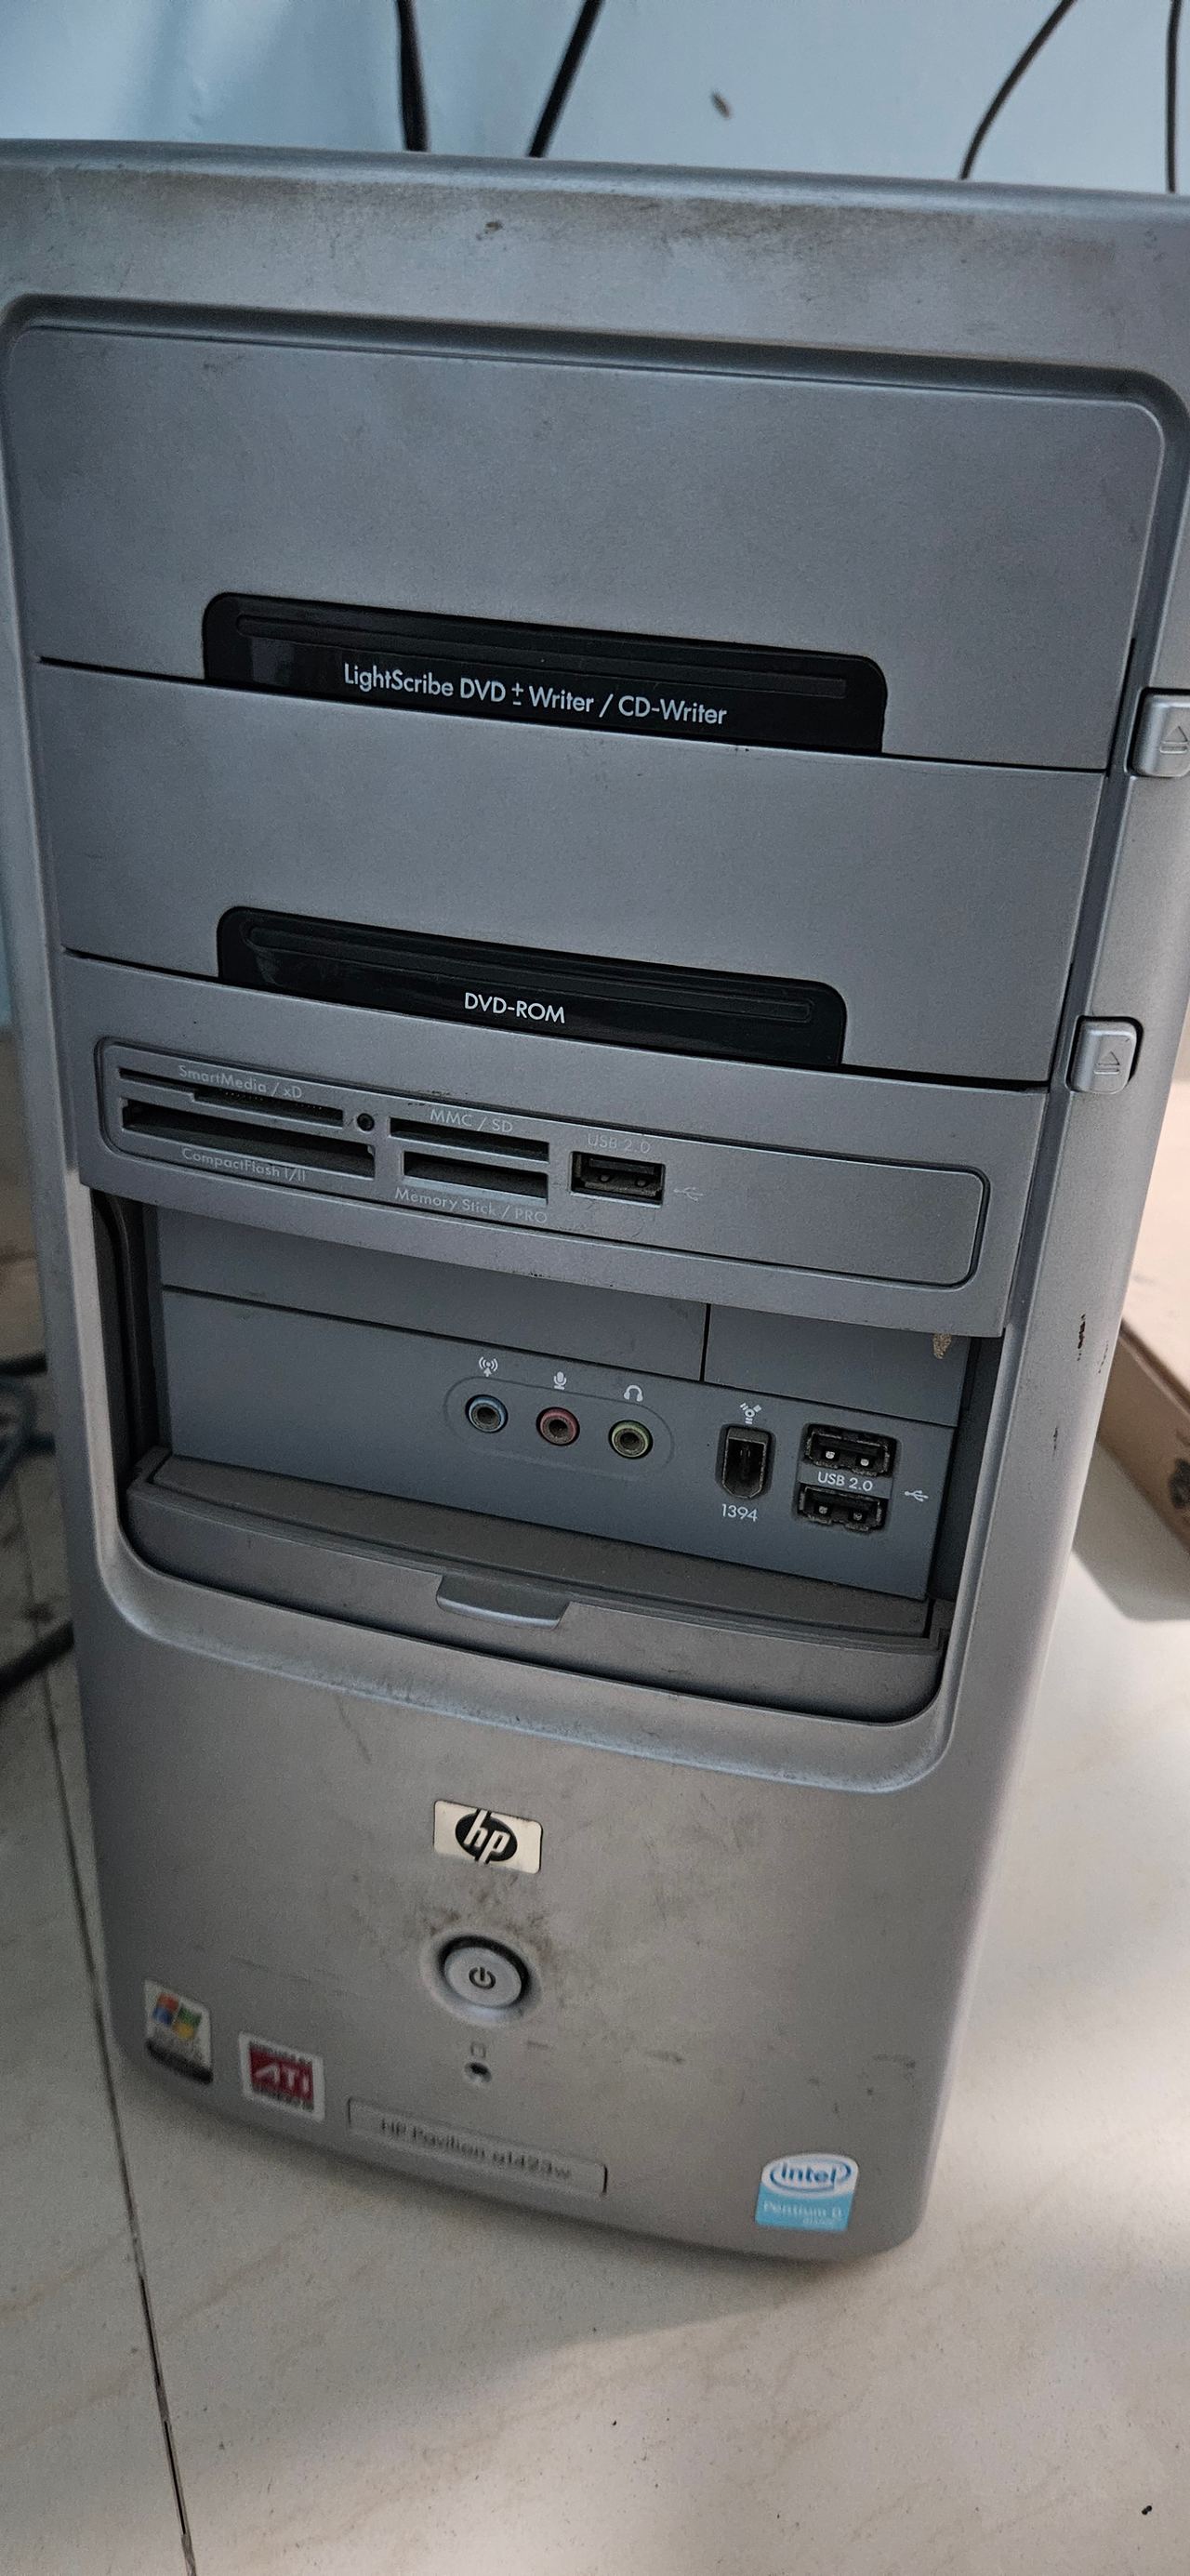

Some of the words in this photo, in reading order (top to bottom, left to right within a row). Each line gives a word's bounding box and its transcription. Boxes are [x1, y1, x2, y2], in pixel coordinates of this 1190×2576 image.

[343, 663, 454, 698] LightScribe
[459, 678, 507, 704] DVD
[529, 686, 594, 713] Writer
[599, 694, 614, 718] /
[618, 695, 728, 725] CD-Writer
[465, 992, 565, 1024] DVD-ROM
[178, 1064, 267, 1093] SmartMedia
[283, 1086, 303, 1100] xD
[430, 1108, 472, 1129] MMC
[492, 1118, 513, 1133] SD
[587, 1133, 617, 1150] USB
[624, 1138, 651, 1155] 2.0
[180, 1145, 280, 1178] CompactFlash
[394, 1186, 458, 1211] Memory
[462, 1199, 495, 1217] Stick
[515, 1209, 549, 1224] PRO
[817, 1472, 845, 1487] USB
[849, 1477, 873, 1492] 2.0
[721, 1504, 758, 1523] 1394
[462, 1808, 511, 1865] hp
